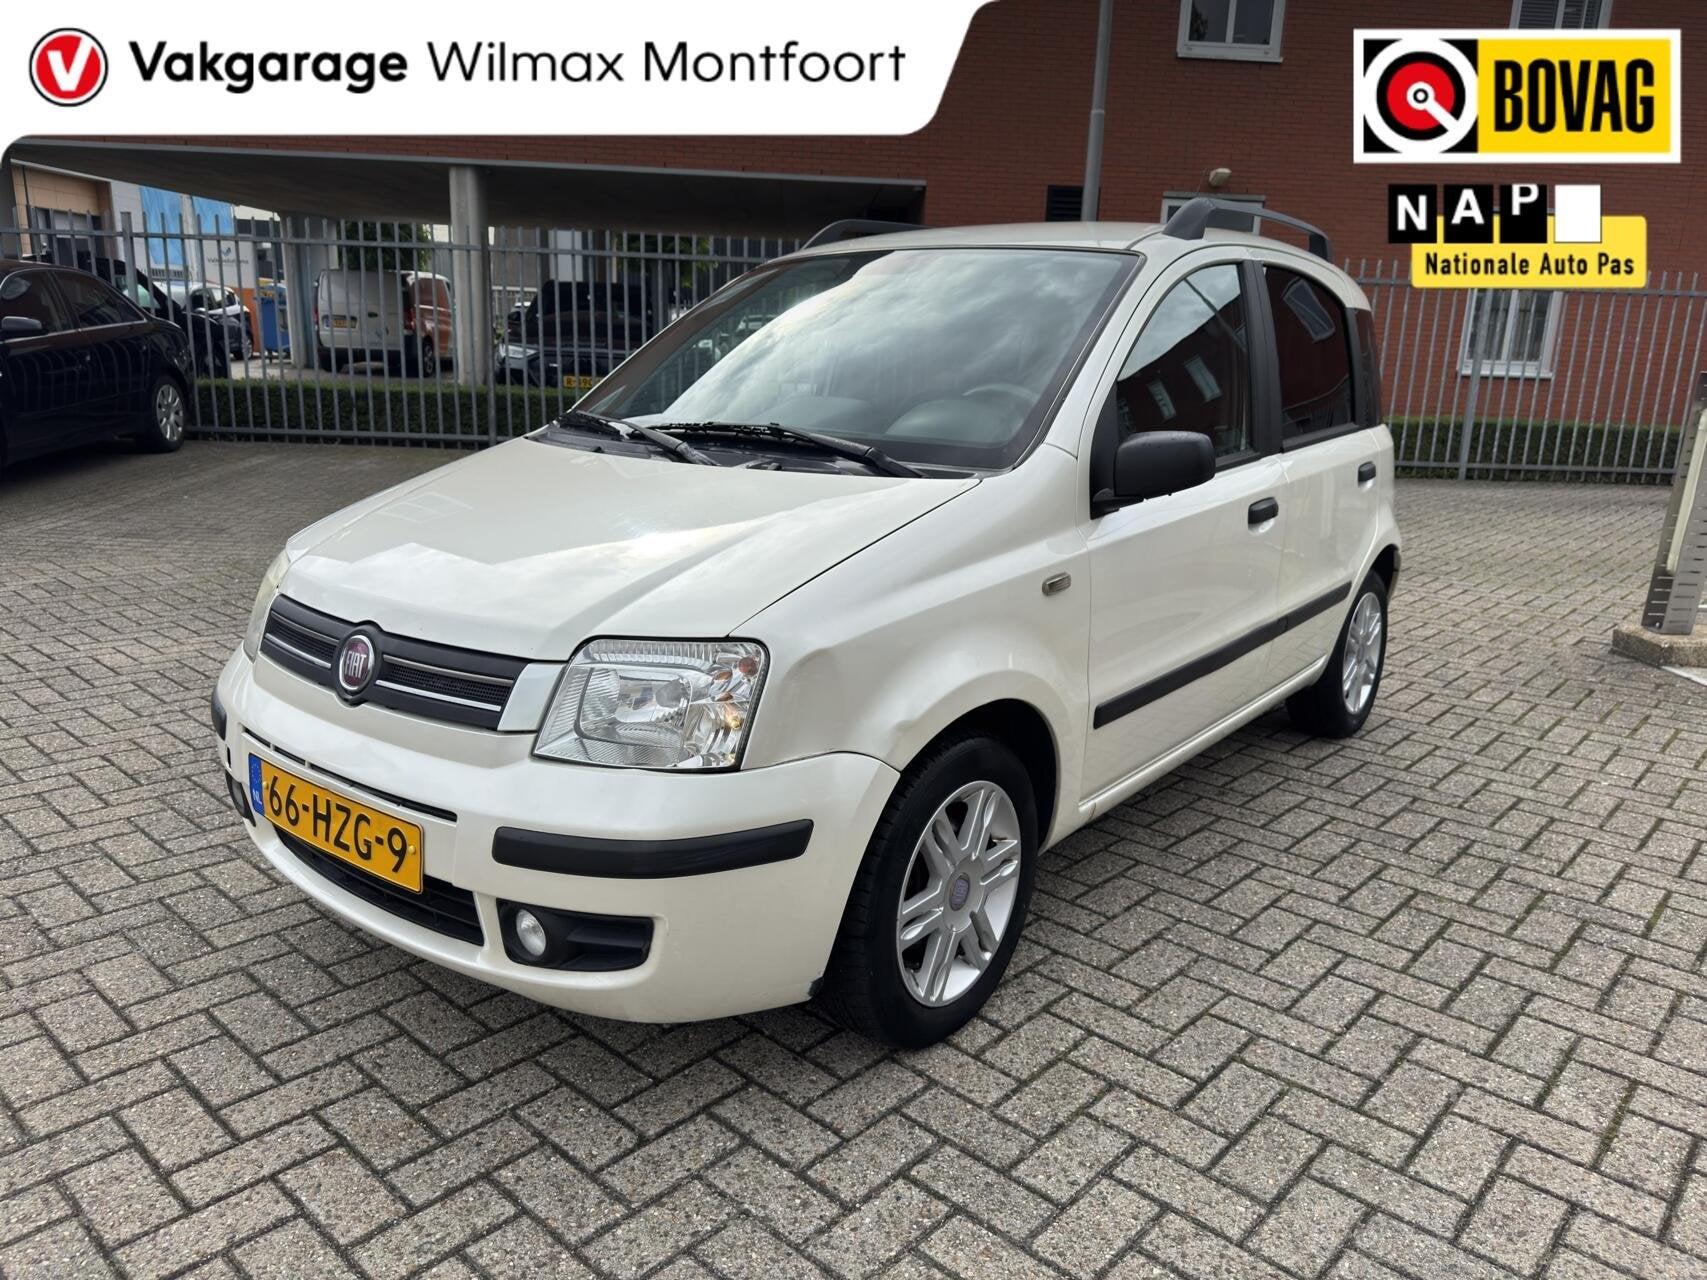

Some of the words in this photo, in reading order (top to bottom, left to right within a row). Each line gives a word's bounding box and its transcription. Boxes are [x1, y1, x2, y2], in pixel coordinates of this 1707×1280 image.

[344, 650, 367, 678] FIAT
[252, 788, 263, 805] NL
[269, 775, 408, 873] 66-HZG-9
